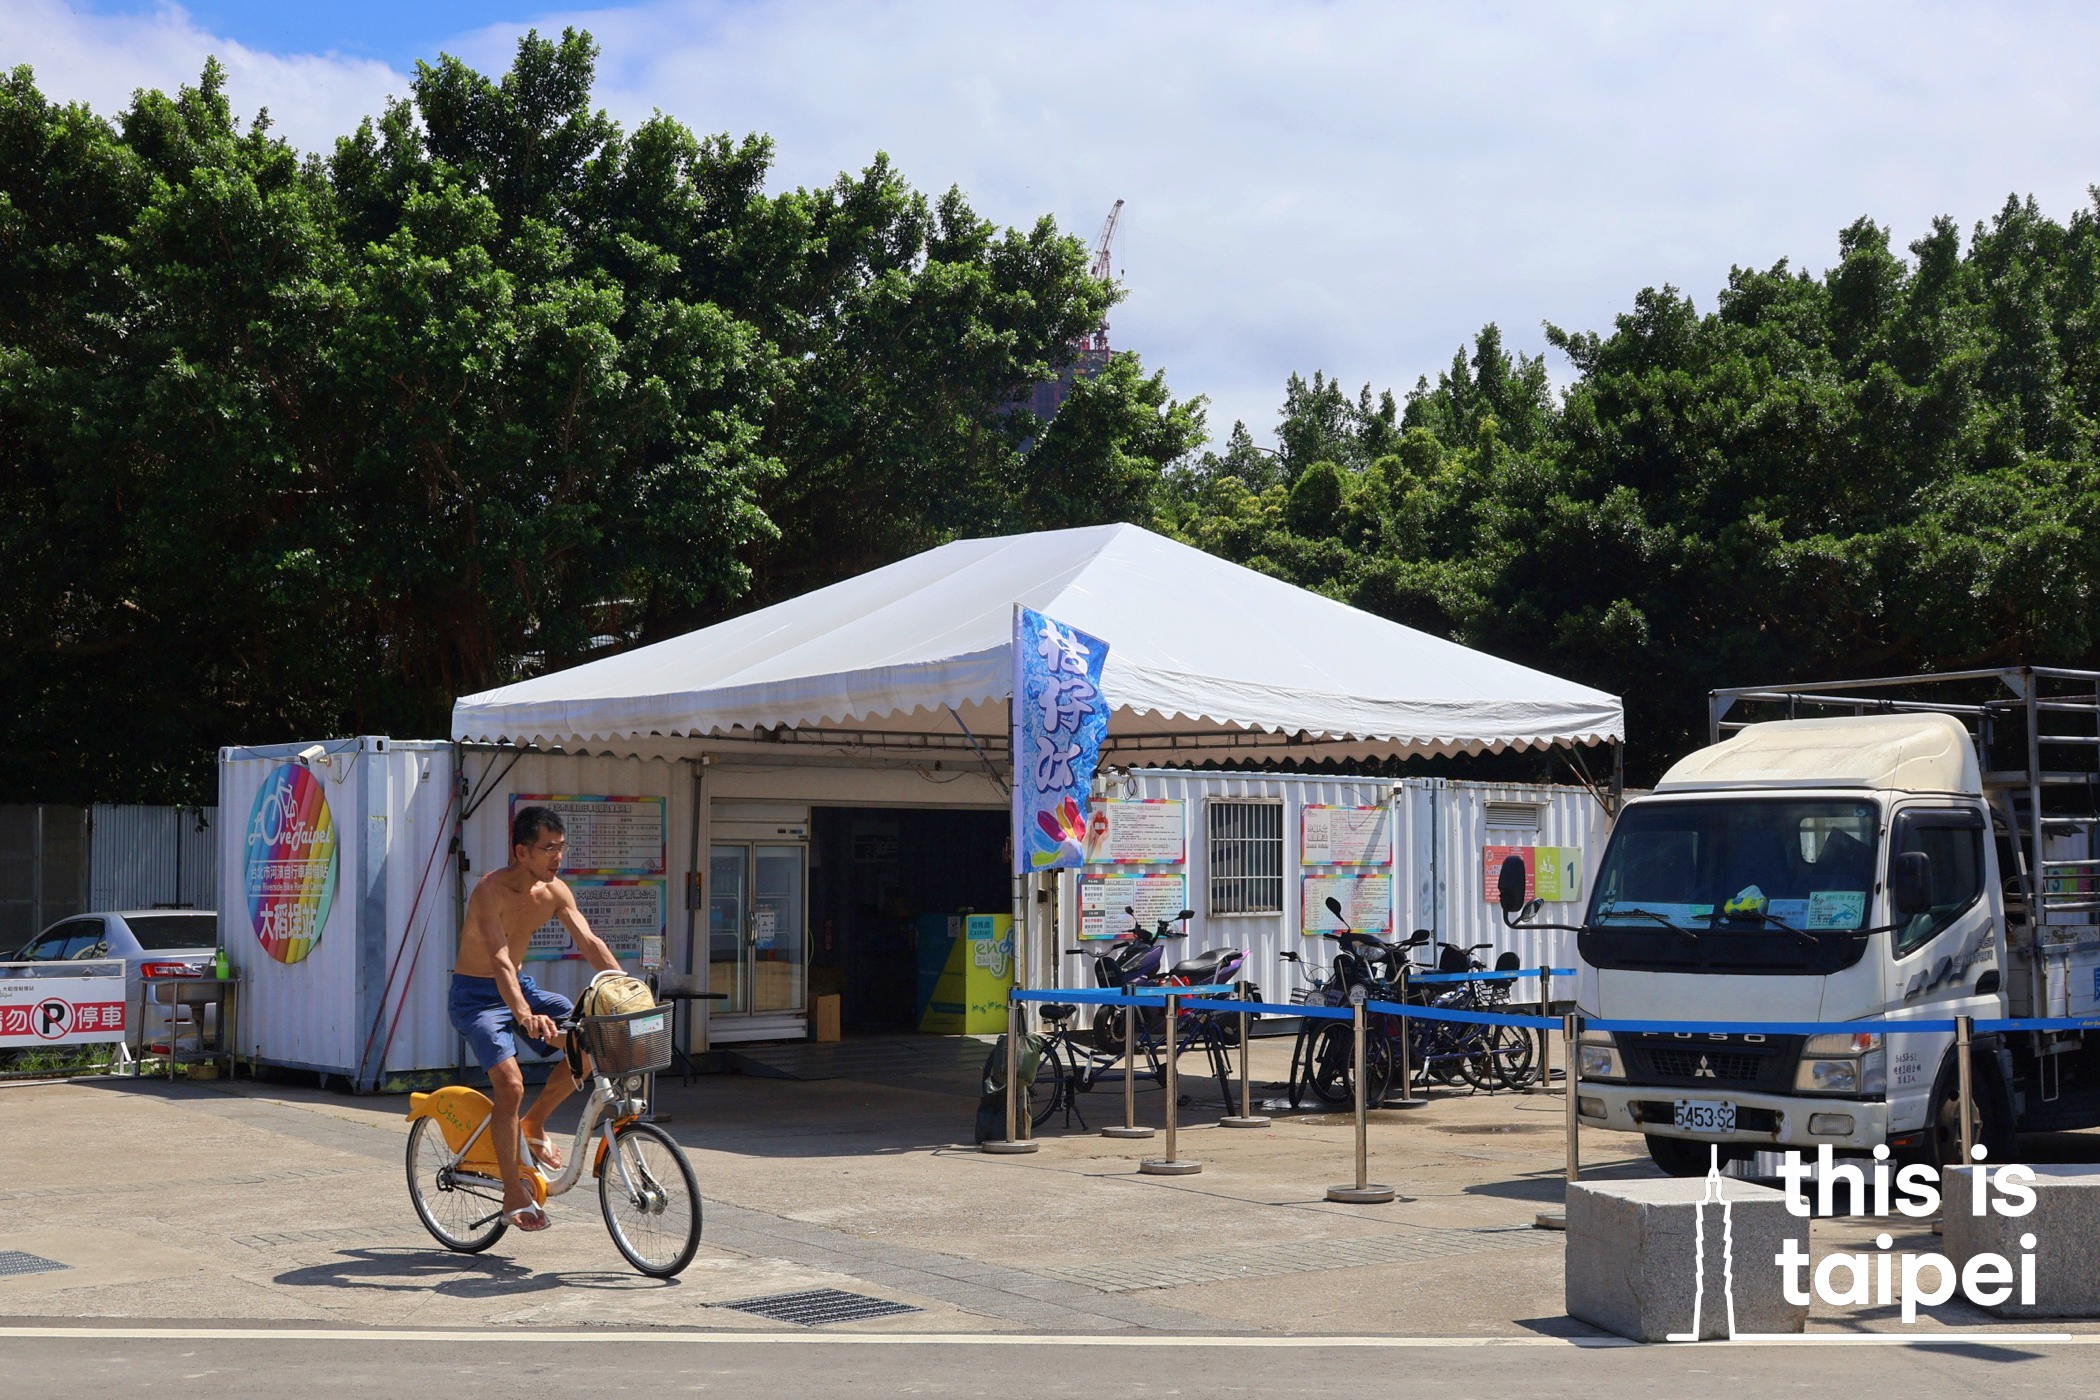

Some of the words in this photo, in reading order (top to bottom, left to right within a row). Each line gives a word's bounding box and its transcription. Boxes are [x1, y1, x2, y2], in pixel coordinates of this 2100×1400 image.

[1567, 862, 1574, 888] 1
[259, 903, 317, 941] 大稻埕站
[78, 1006, 122, 1029] 停車
